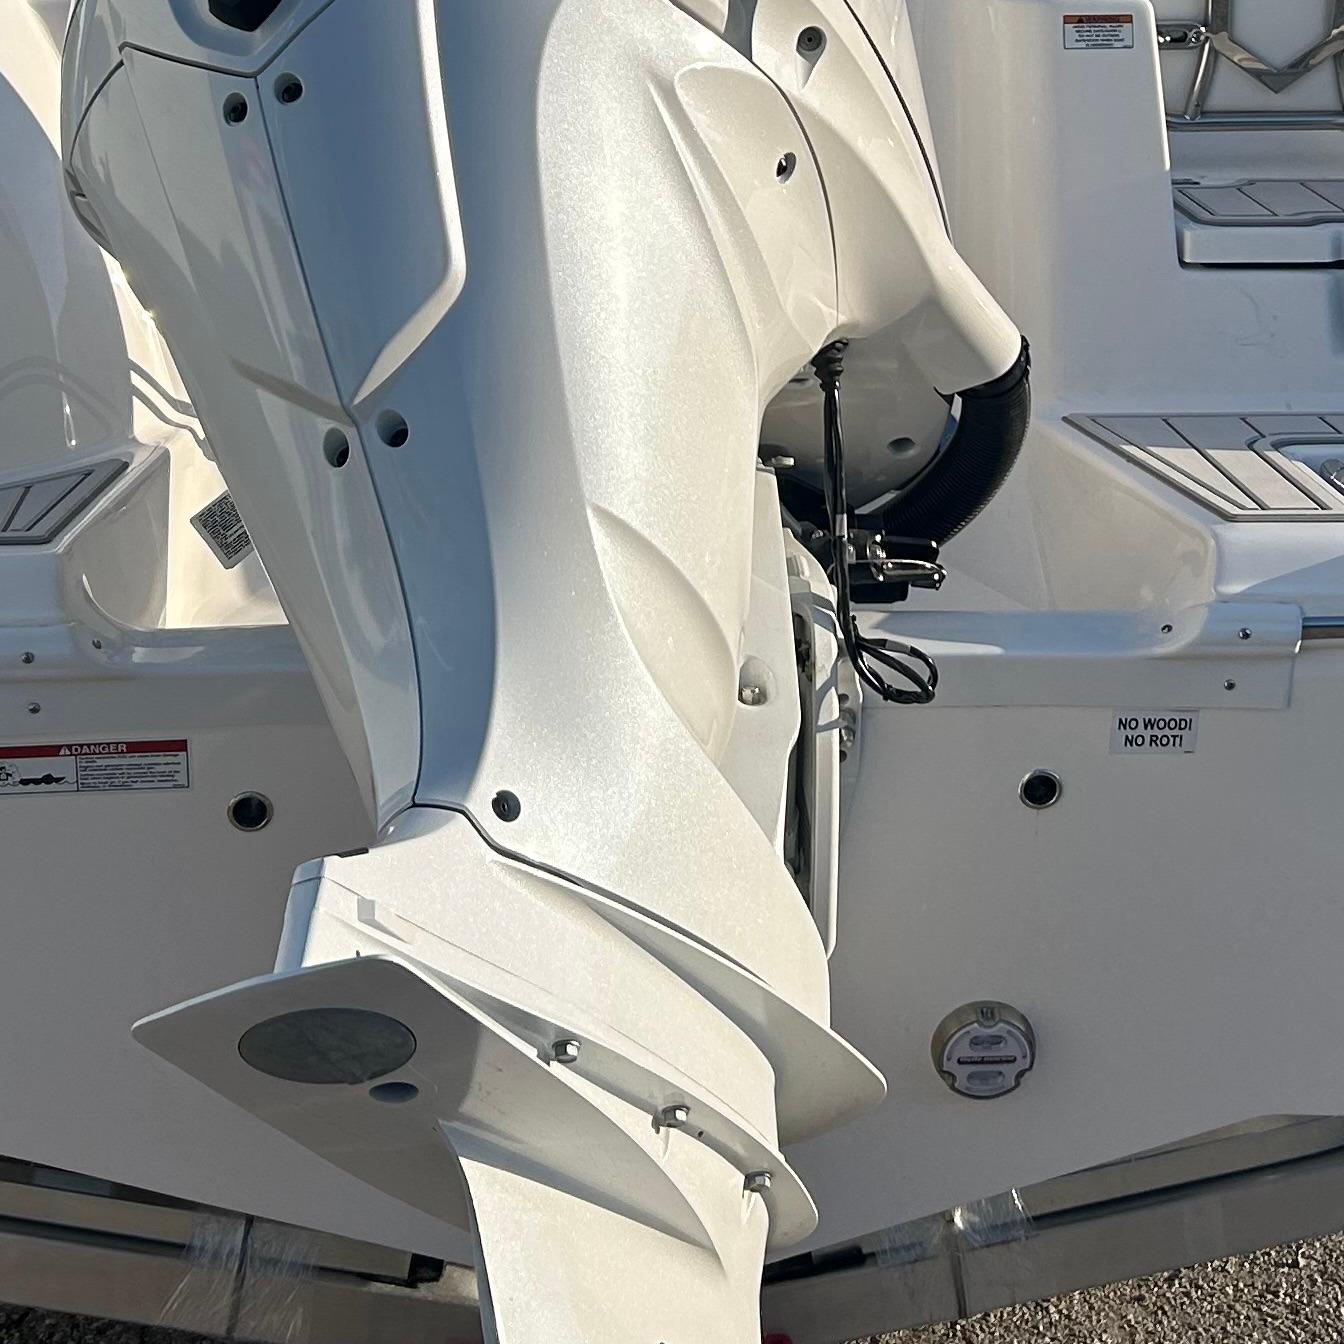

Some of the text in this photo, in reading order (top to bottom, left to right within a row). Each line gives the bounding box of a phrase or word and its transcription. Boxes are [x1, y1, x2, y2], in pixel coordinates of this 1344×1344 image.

[1117, 718, 1139, 731] NO
[1124, 734, 1145, 747] NO
[71, 743, 127, 755] DANGER
